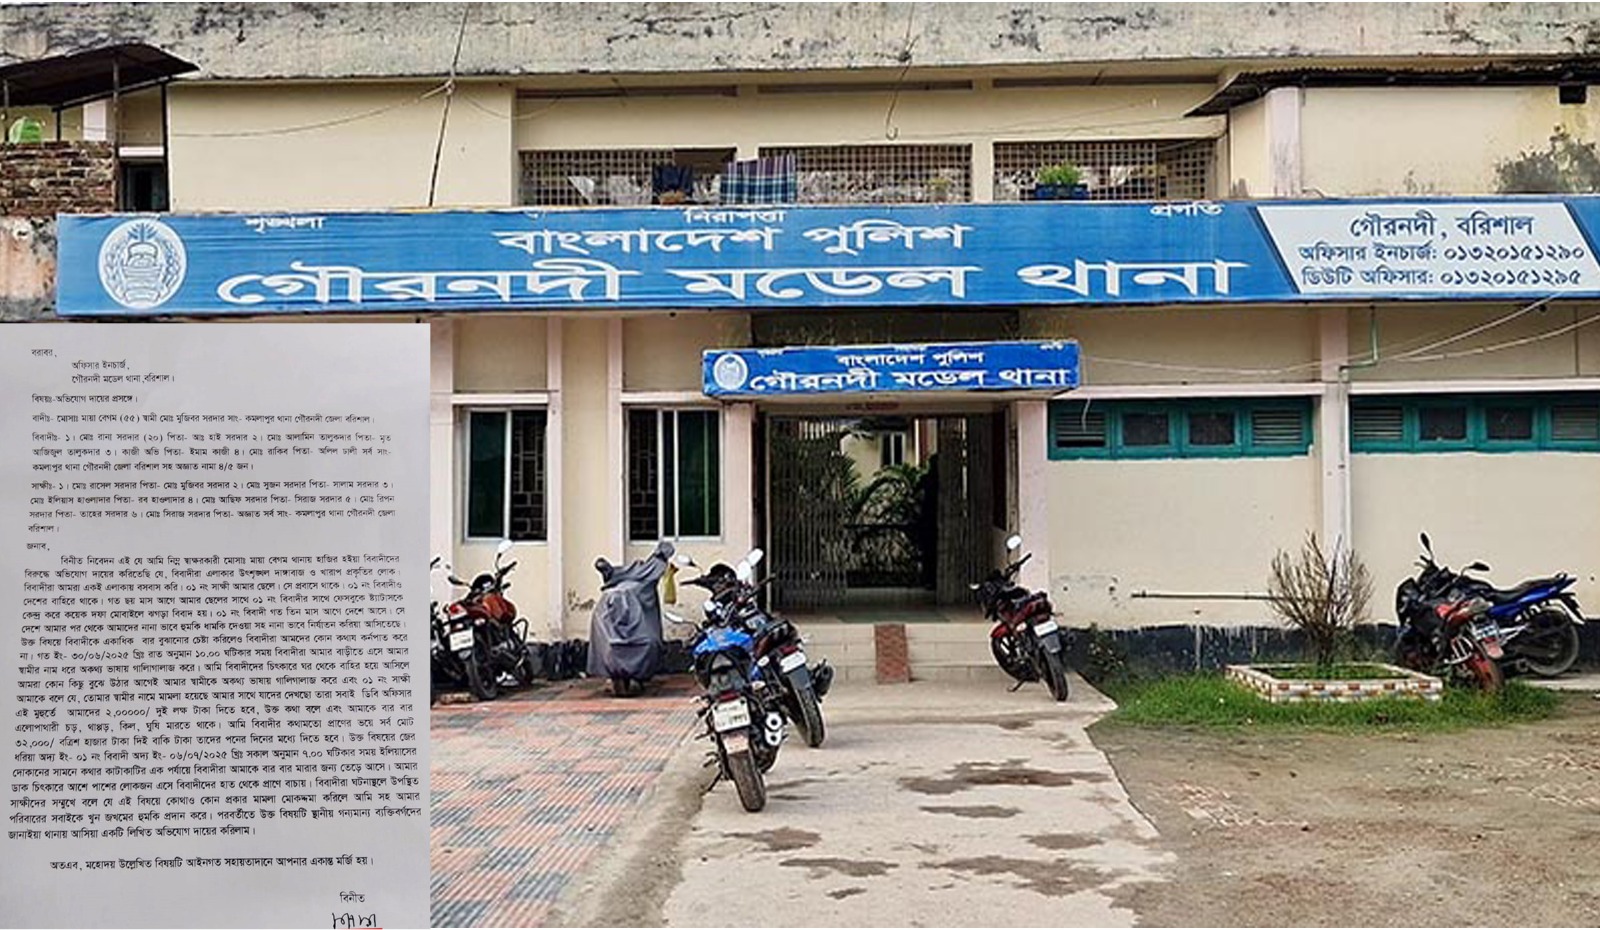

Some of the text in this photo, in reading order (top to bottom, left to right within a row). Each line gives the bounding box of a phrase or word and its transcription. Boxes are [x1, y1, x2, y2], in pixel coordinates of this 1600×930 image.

[1455, 210, 1534, 235] বরিশাল
[491, 219, 975, 256] বাংলাদেশ পুলিশ
[1299, 241, 1367, 260] অফিসার
[1444, 245, 1585, 262] ০১৩২০১৫১২৯০
[217, 257, 1250, 304] গৌরনদী মডেল থানা
[1302, 266, 1354, 284] ডিউটি
[1440, 270, 1581, 286] ০১৩২০১৫১২৯৫
[837, 350, 984, 367] বাংলাদেশ পুলিশ
[750, 367, 1072, 390] গৌরনদী মডেল থানা
